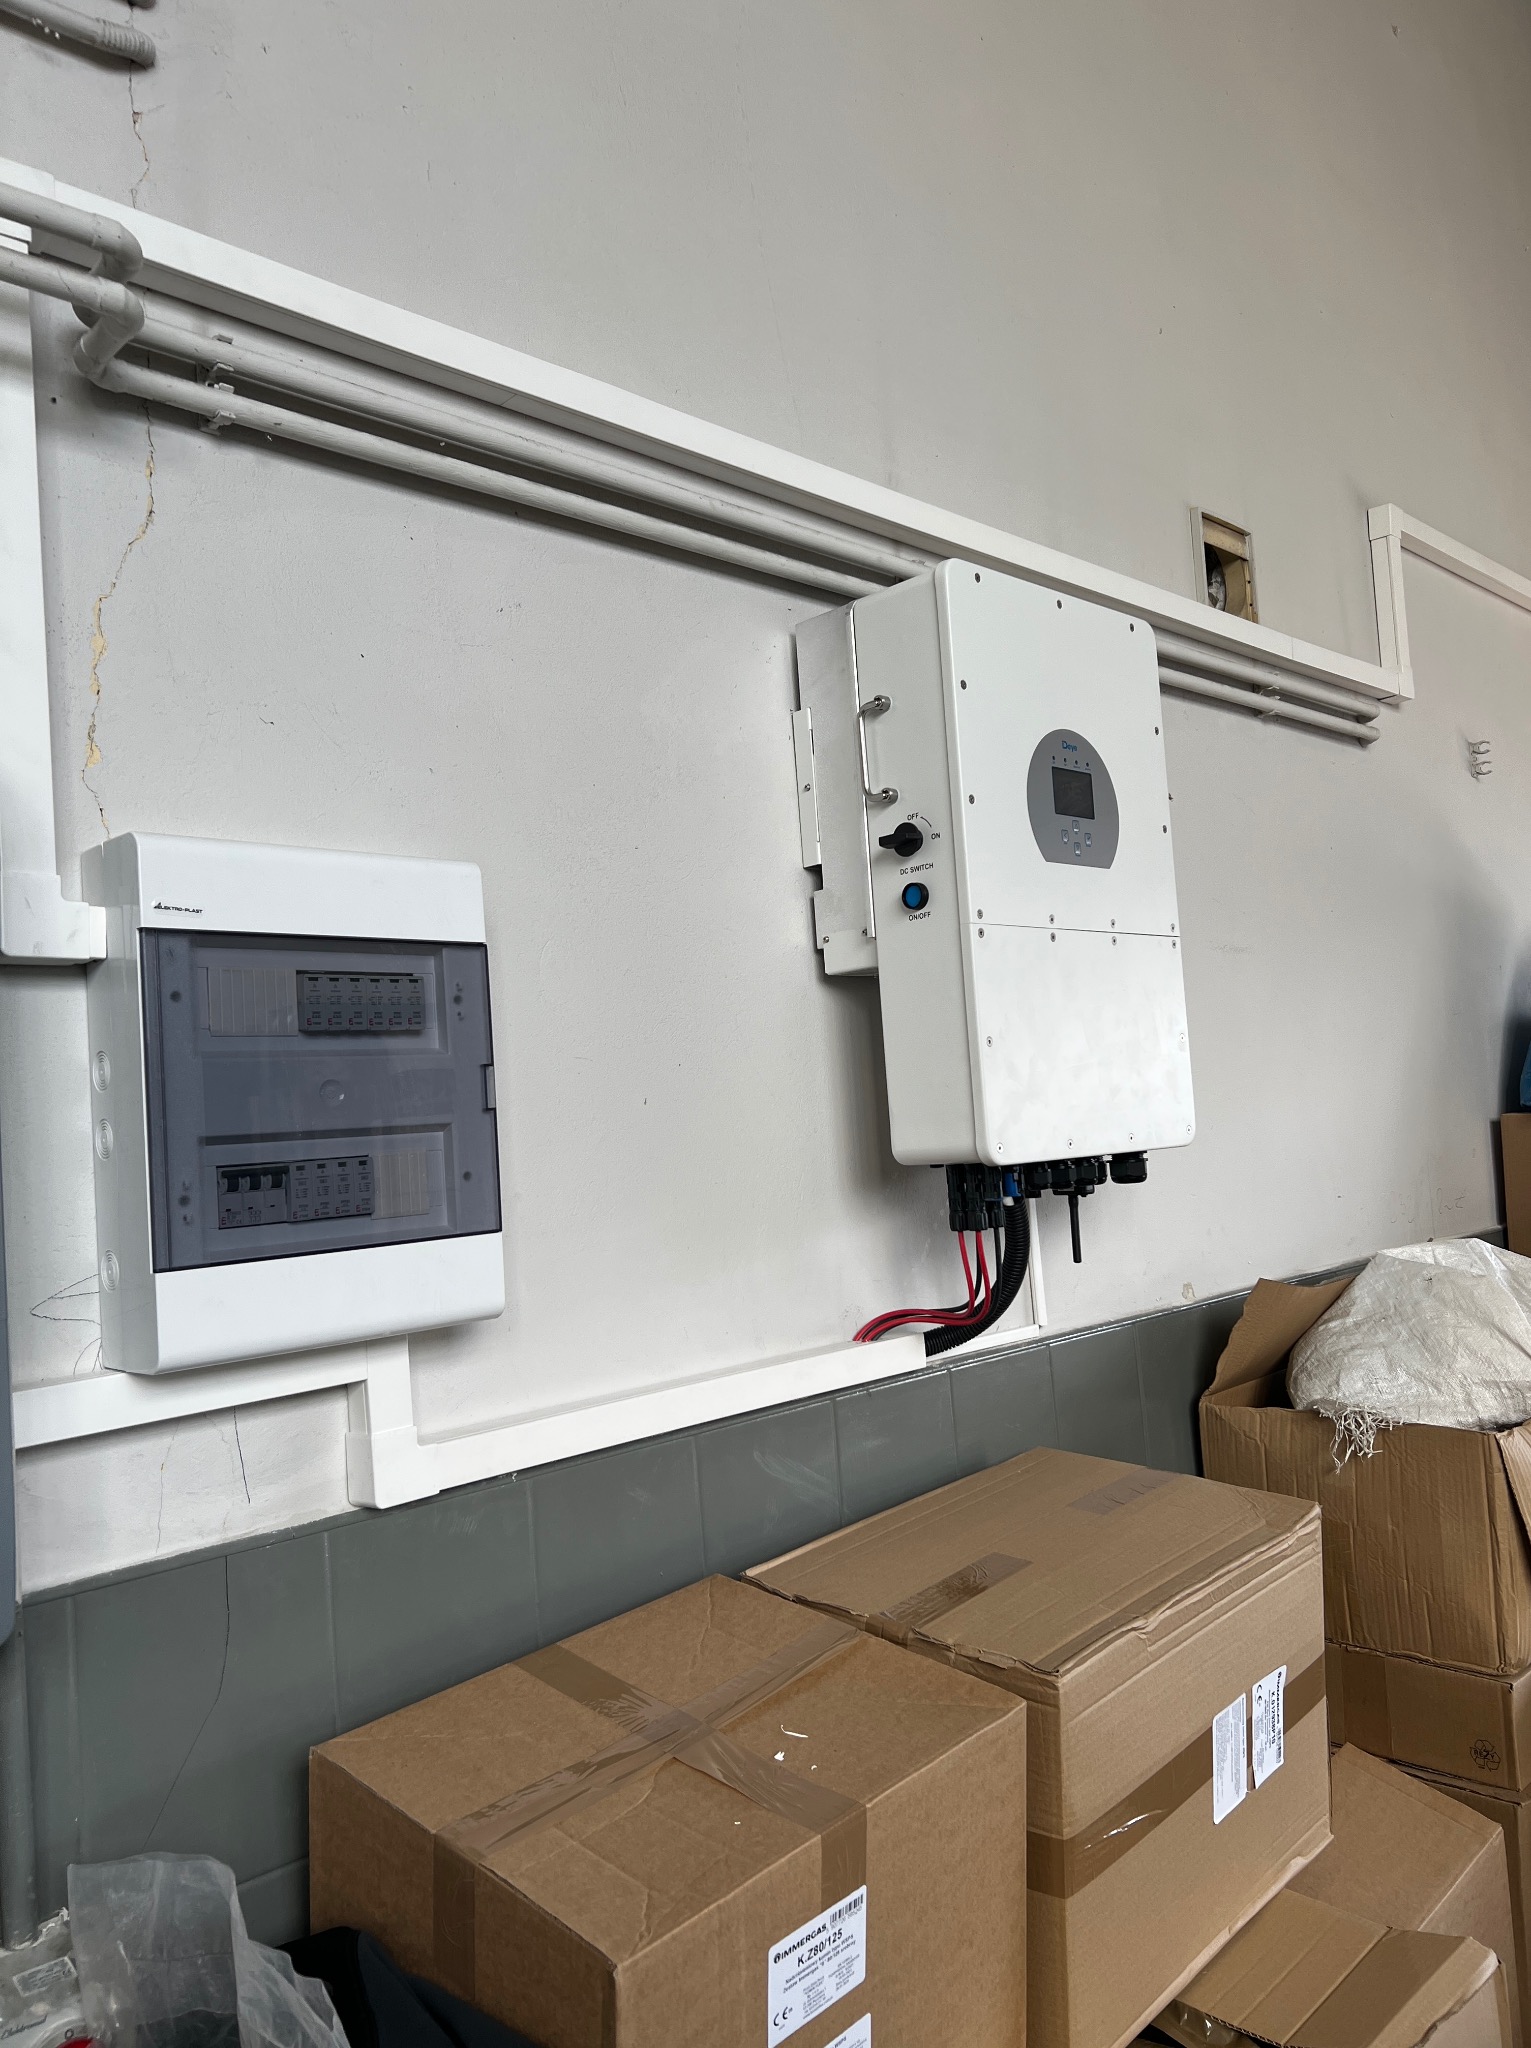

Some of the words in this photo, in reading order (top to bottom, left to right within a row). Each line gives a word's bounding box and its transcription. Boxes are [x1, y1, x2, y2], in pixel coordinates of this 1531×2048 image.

[907, 812, 919, 821] OFF
[931, 832, 941, 840] ON
[900, 867, 909, 875] DC
[910, 862, 934, 873] SWITCH
[908, 911, 931, 921] ON/OFF
[782, 1923, 826, 1959] IMMERGAS
[798, 1928, 842, 1967] K.Z80/125
